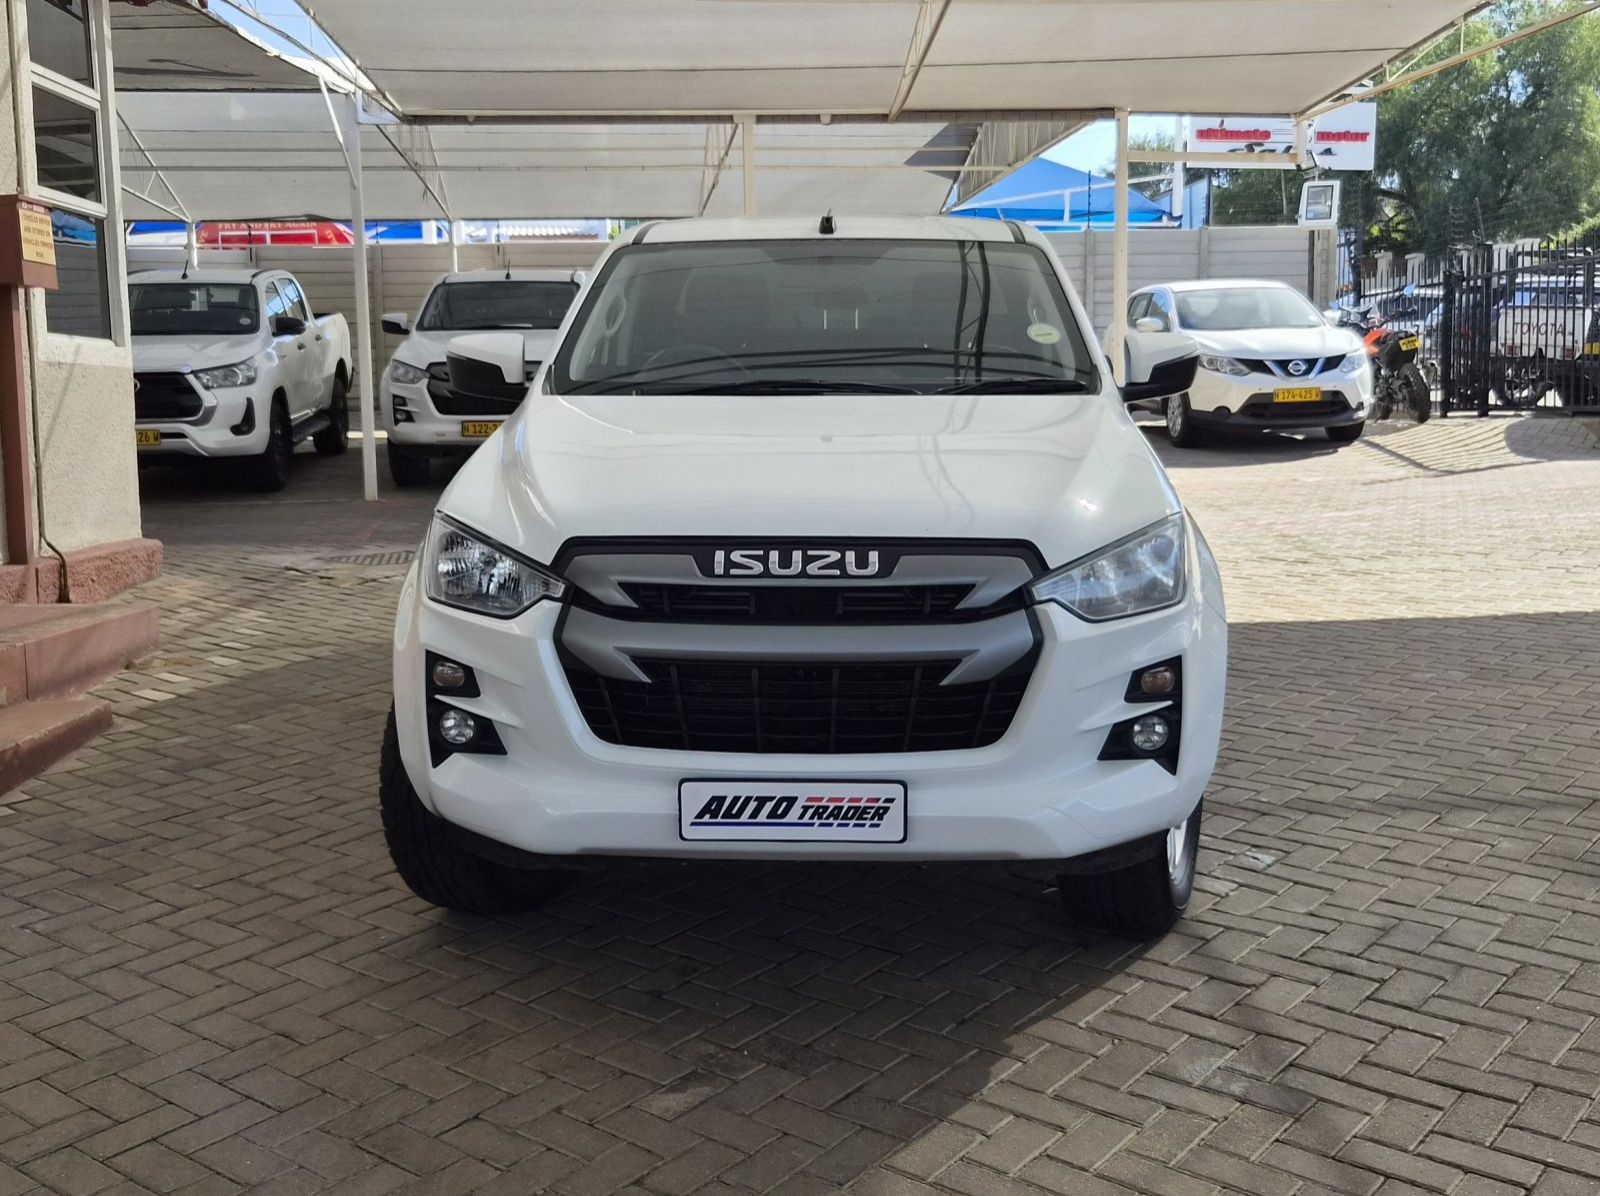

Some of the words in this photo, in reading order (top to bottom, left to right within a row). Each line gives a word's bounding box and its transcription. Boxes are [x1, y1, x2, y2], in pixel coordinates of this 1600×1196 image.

[1316, 130, 1370, 143] motor
[1513, 322, 1565, 336] TOYOTA
[714, 549, 879, 575] ISUZU
[693, 795, 799, 819] AUTO
[797, 805, 891, 821] TRADER
